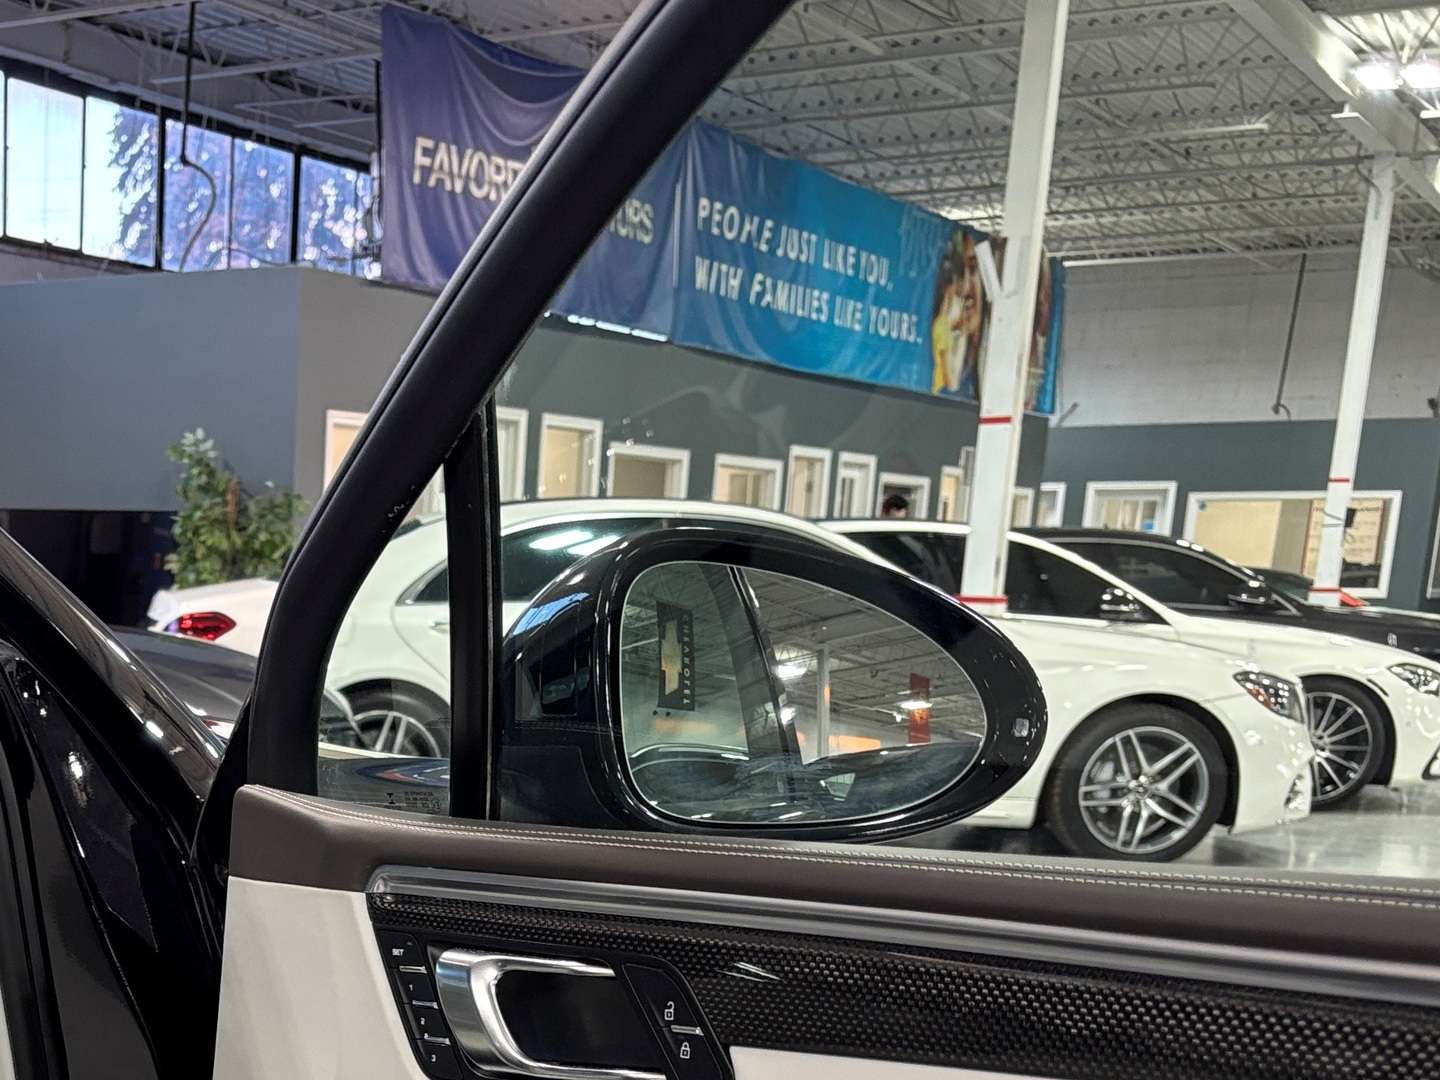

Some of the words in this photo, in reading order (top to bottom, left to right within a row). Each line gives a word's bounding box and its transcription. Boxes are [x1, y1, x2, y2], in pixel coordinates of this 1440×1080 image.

[776, 225, 817, 264] JUST
[823, 239, 857, 277] LIKE
[695, 255, 744, 300] WITH
[749, 272, 830, 323] FAMILIES
[391, 948, 405, 957] SET
